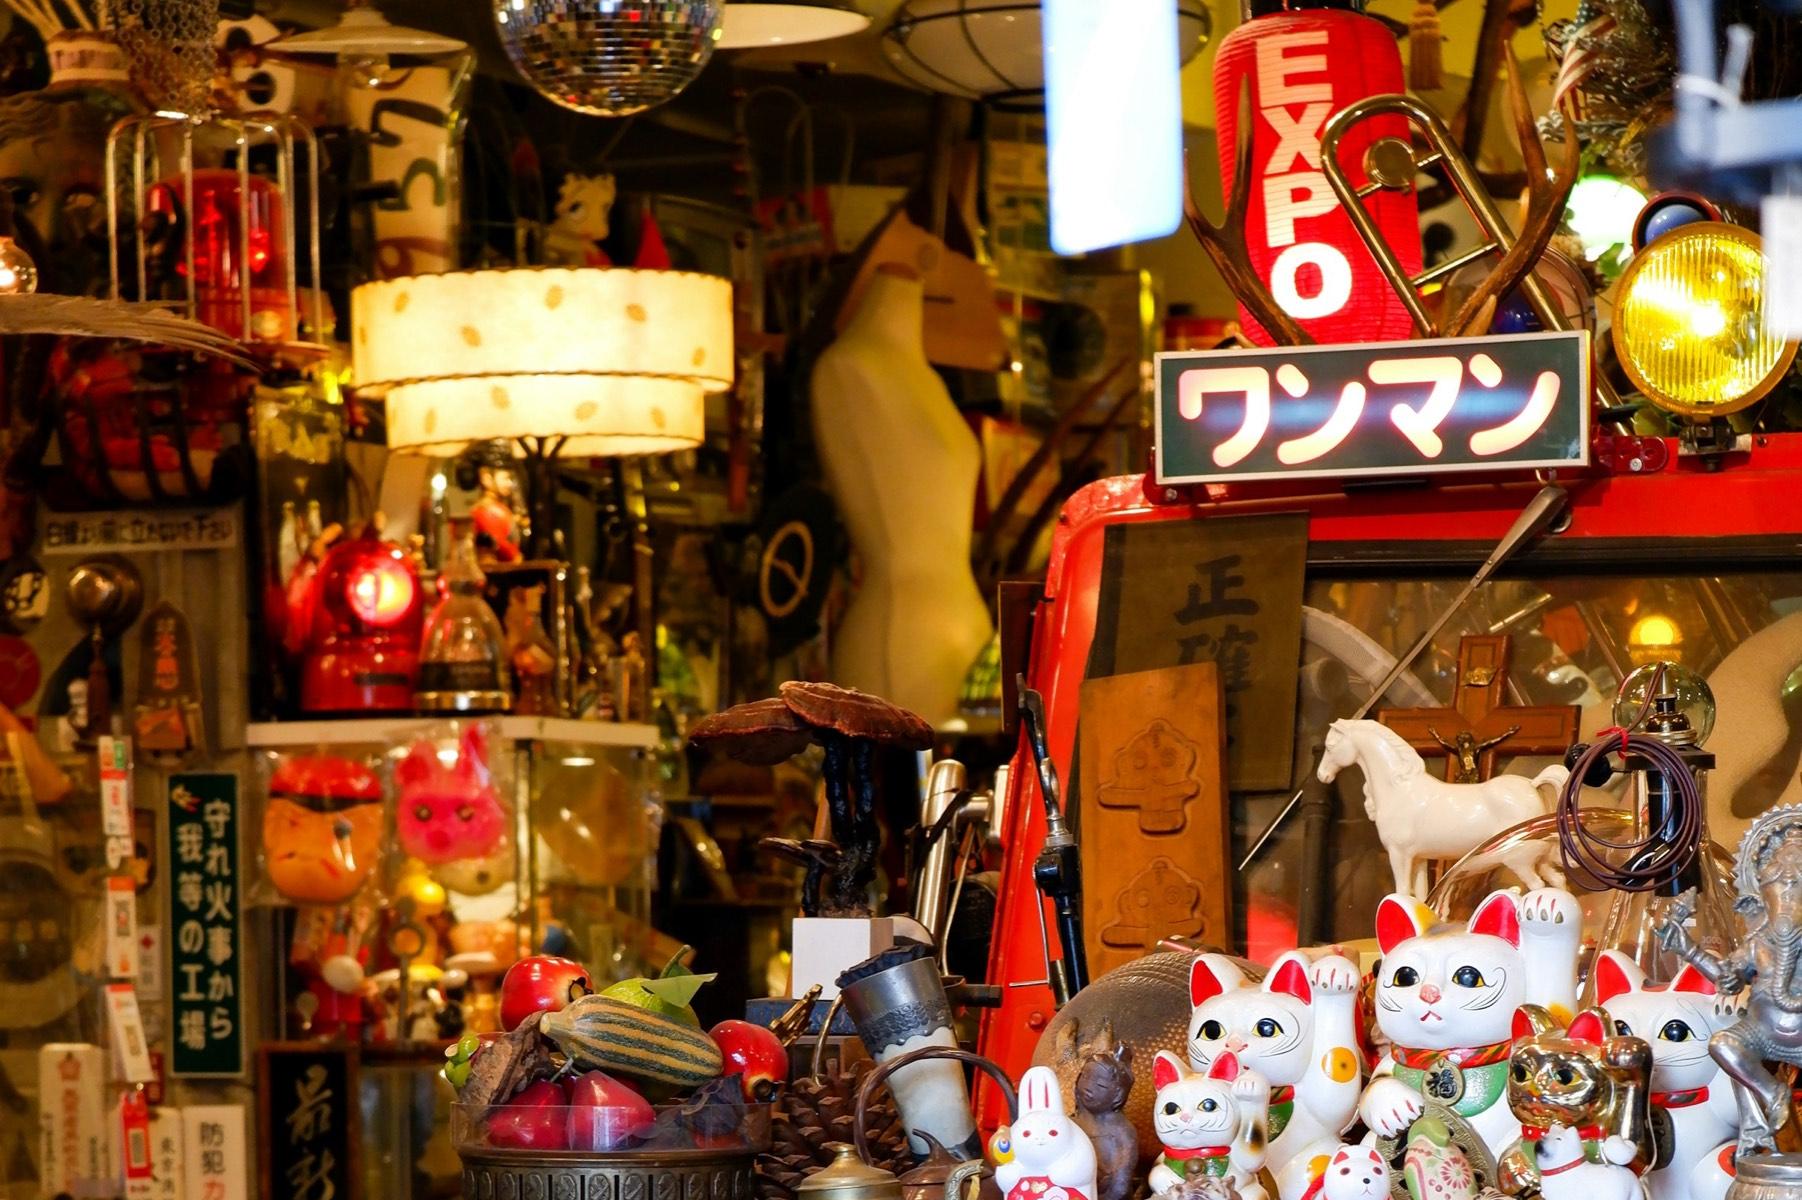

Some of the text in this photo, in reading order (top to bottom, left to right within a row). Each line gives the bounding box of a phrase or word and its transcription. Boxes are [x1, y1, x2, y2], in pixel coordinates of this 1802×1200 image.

[1255, 30, 1353, 320] EXPO
[1178, 353, 1561, 467] ワンマン
[176, 822, 207, 1050] 我等の工場
[203, 798, 234, 1040] 守れ火事から
